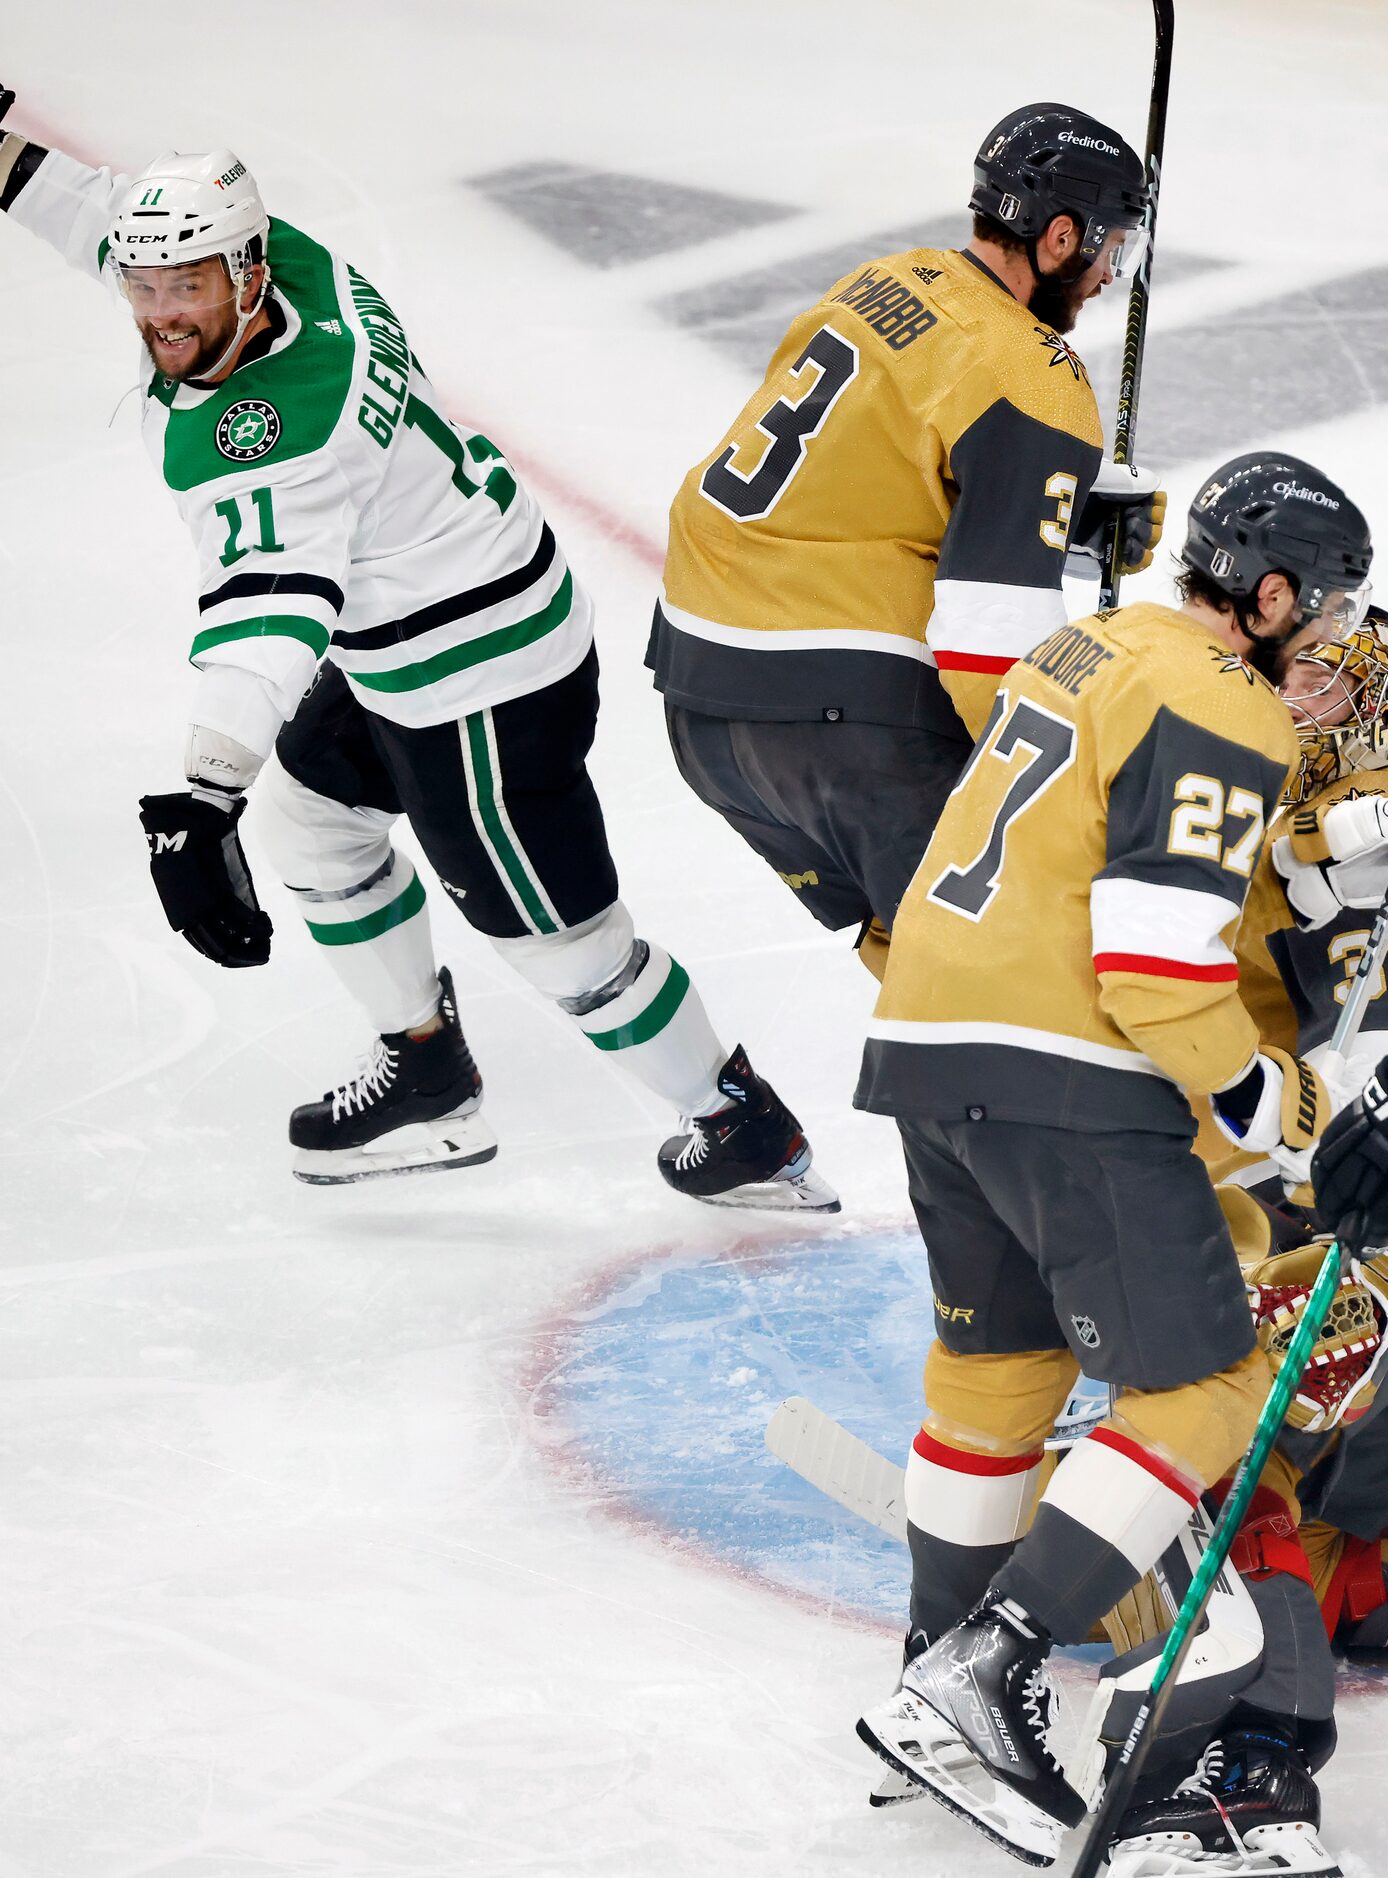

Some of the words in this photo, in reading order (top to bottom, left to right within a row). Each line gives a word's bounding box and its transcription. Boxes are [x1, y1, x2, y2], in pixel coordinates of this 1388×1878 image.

[140, 188, 163, 206] 11
[126, 235, 168, 244] CCM
[220, 403, 275, 432] DALLAS
[224, 434, 274, 457] STARS
[698, 323, 860, 524] 3
[214, 486, 286, 569] 11
[1040, 472, 1080, 553] 3
[1167, 772, 1264, 878] 27
[989, 1706, 1020, 1763] BAUER
